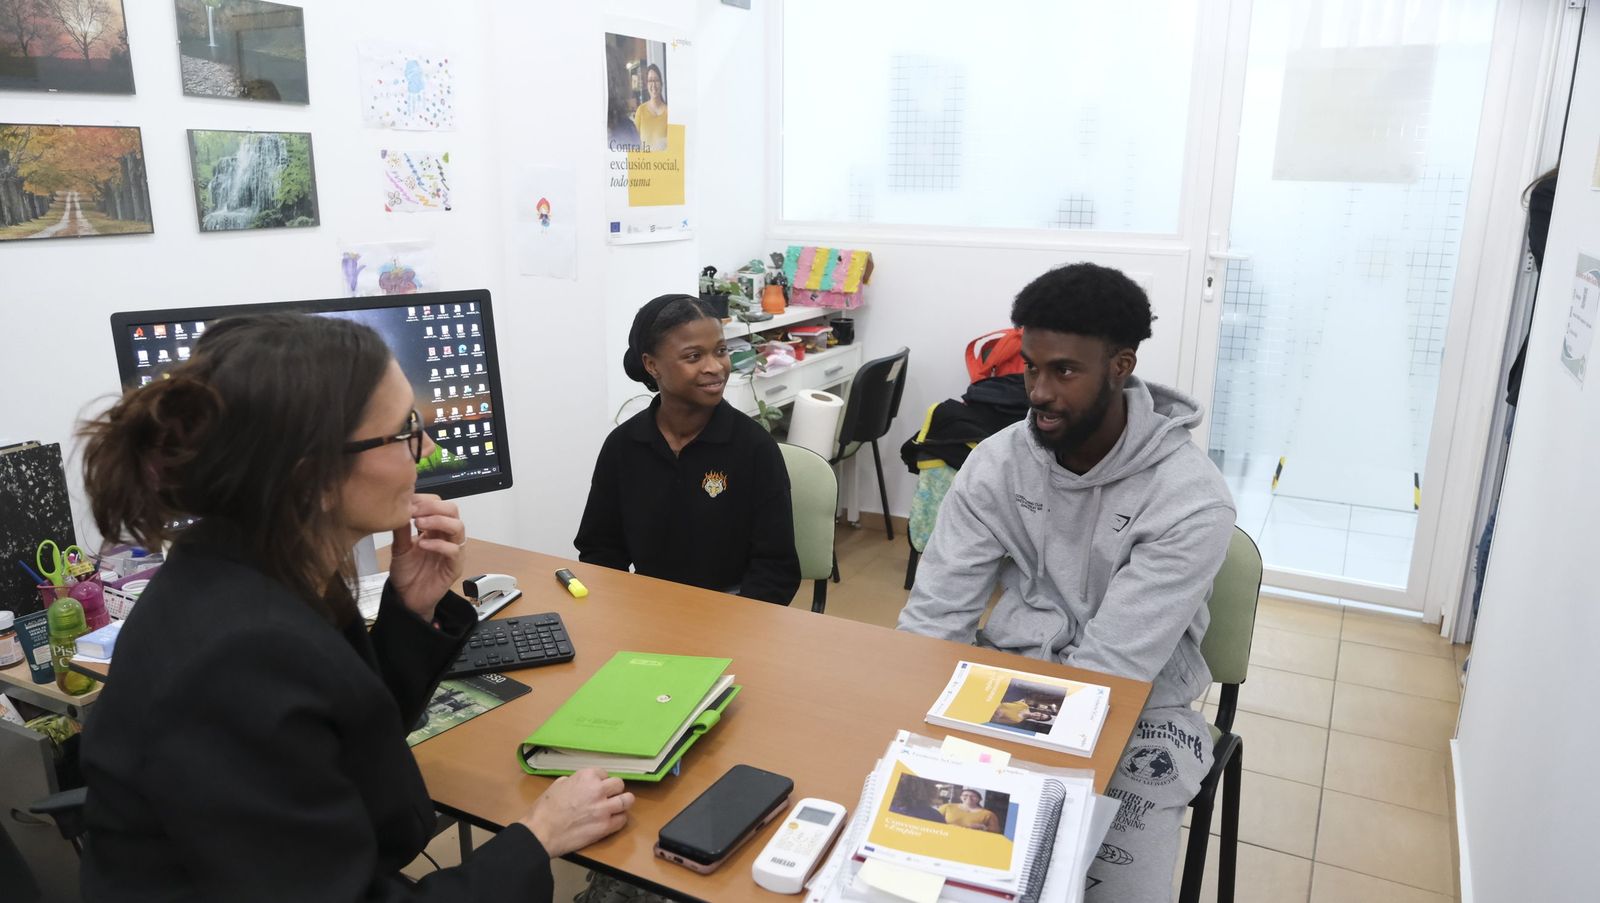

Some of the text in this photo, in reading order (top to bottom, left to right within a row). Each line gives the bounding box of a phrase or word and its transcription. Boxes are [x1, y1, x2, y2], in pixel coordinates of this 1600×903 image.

[610, 139, 651, 153] Contra la
[610, 157, 680, 171] exclusión social,
[610, 175, 651, 187] todo suma
[482, 673, 507, 684] SSO
[1117, 808, 1142, 821] ENTIC
[1115, 814, 1145, 831] IONING
